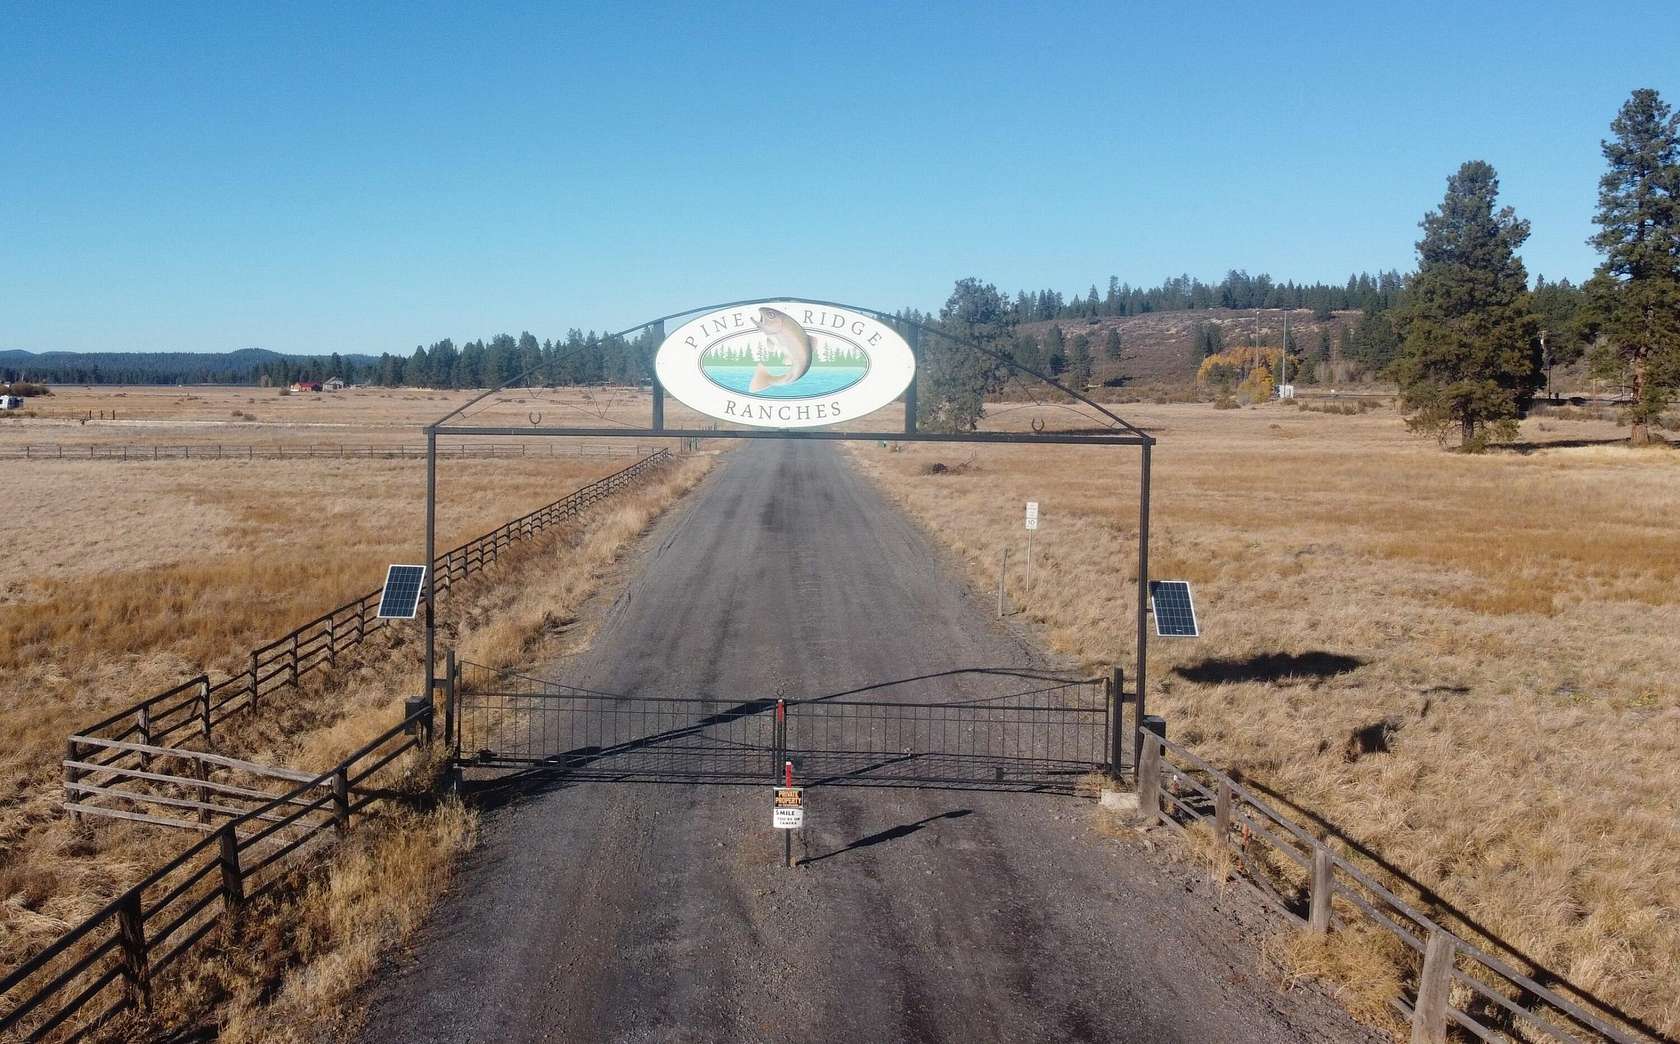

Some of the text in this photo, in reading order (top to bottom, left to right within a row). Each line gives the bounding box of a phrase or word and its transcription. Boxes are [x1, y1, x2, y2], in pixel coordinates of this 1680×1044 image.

[684, 310, 883, 349] PINE RIDGE
[725, 400, 841, 421] RANCHES
